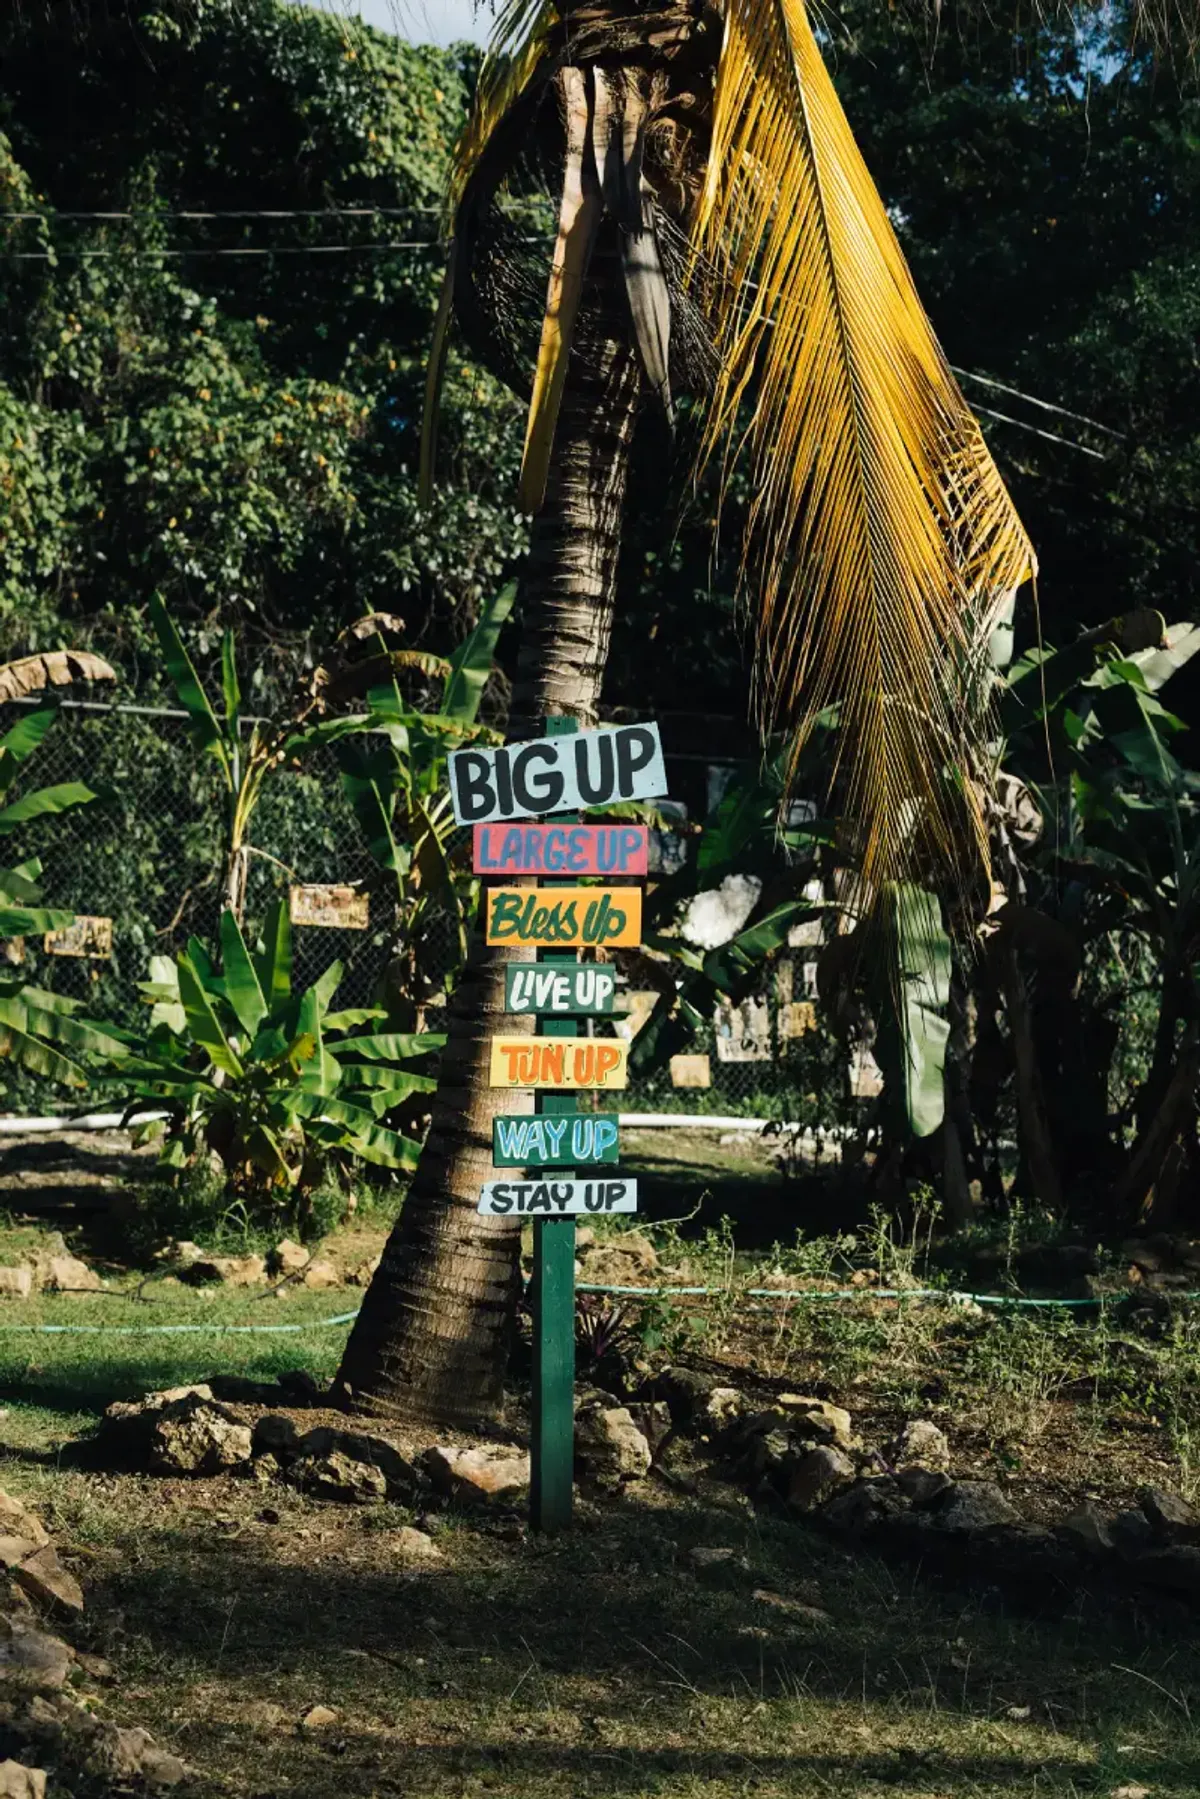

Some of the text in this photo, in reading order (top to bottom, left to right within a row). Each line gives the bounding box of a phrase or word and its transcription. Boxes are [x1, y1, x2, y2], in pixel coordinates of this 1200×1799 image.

[454, 727, 656, 821] BIG UP
[479, 828, 643, 872] LARGE UP
[510, 969, 614, 1011] LIVE UP
[500, 1044, 622, 1086] TUN UP
[496, 1118, 617, 1161] WAY UP
[489, 1181, 627, 1213] STAY UP
